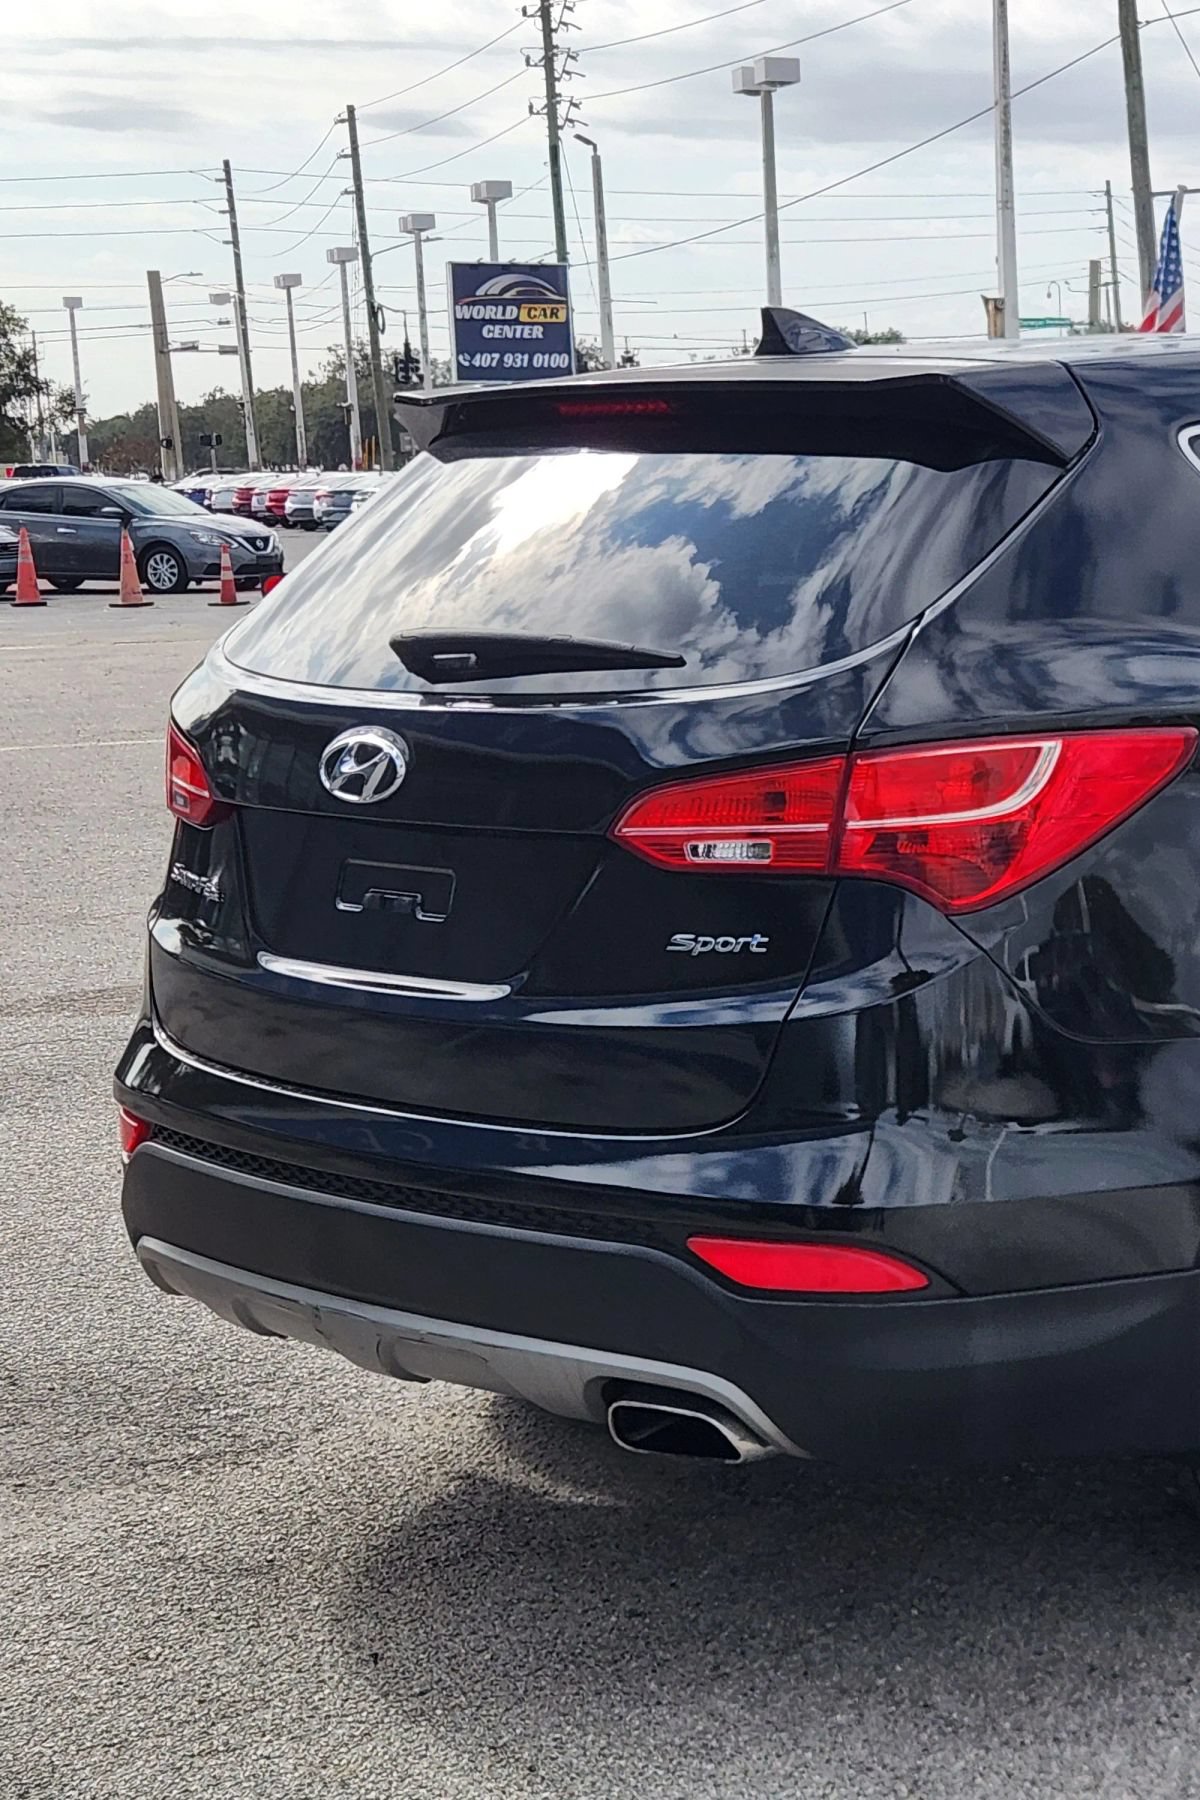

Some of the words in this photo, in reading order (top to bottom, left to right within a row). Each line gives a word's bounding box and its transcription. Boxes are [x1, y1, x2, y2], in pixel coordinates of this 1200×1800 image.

[455, 304, 518, 320] WORLD
[527, 306, 560, 320] CAR
[482, 324, 544, 339] CENTER
[471, 353, 500, 368] 407
[503, 353, 528, 368] 931
[532, 352, 569, 368] 0100
[666, 933, 769, 956] Sport
